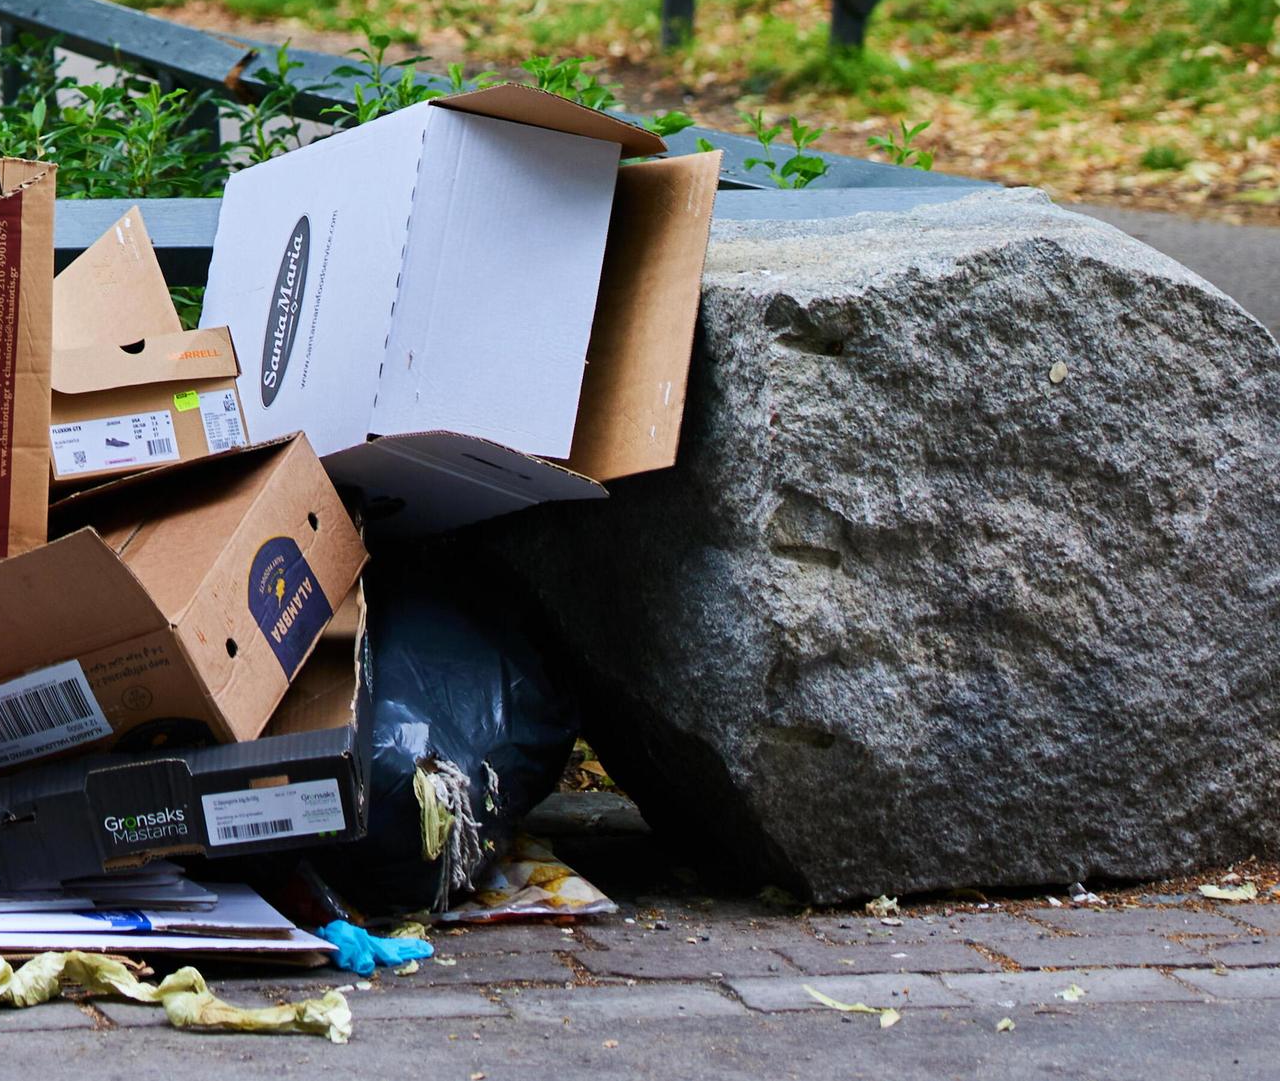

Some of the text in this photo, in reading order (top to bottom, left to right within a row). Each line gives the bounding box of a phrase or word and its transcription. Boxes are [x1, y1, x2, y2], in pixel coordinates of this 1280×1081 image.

[0, 267, 19, 477] www.chasiotis.gr chasiotis@chasiotis.gr
[263, 231, 304, 388] Santa Maria
[270, 576, 313, 643] ALAMBRA
